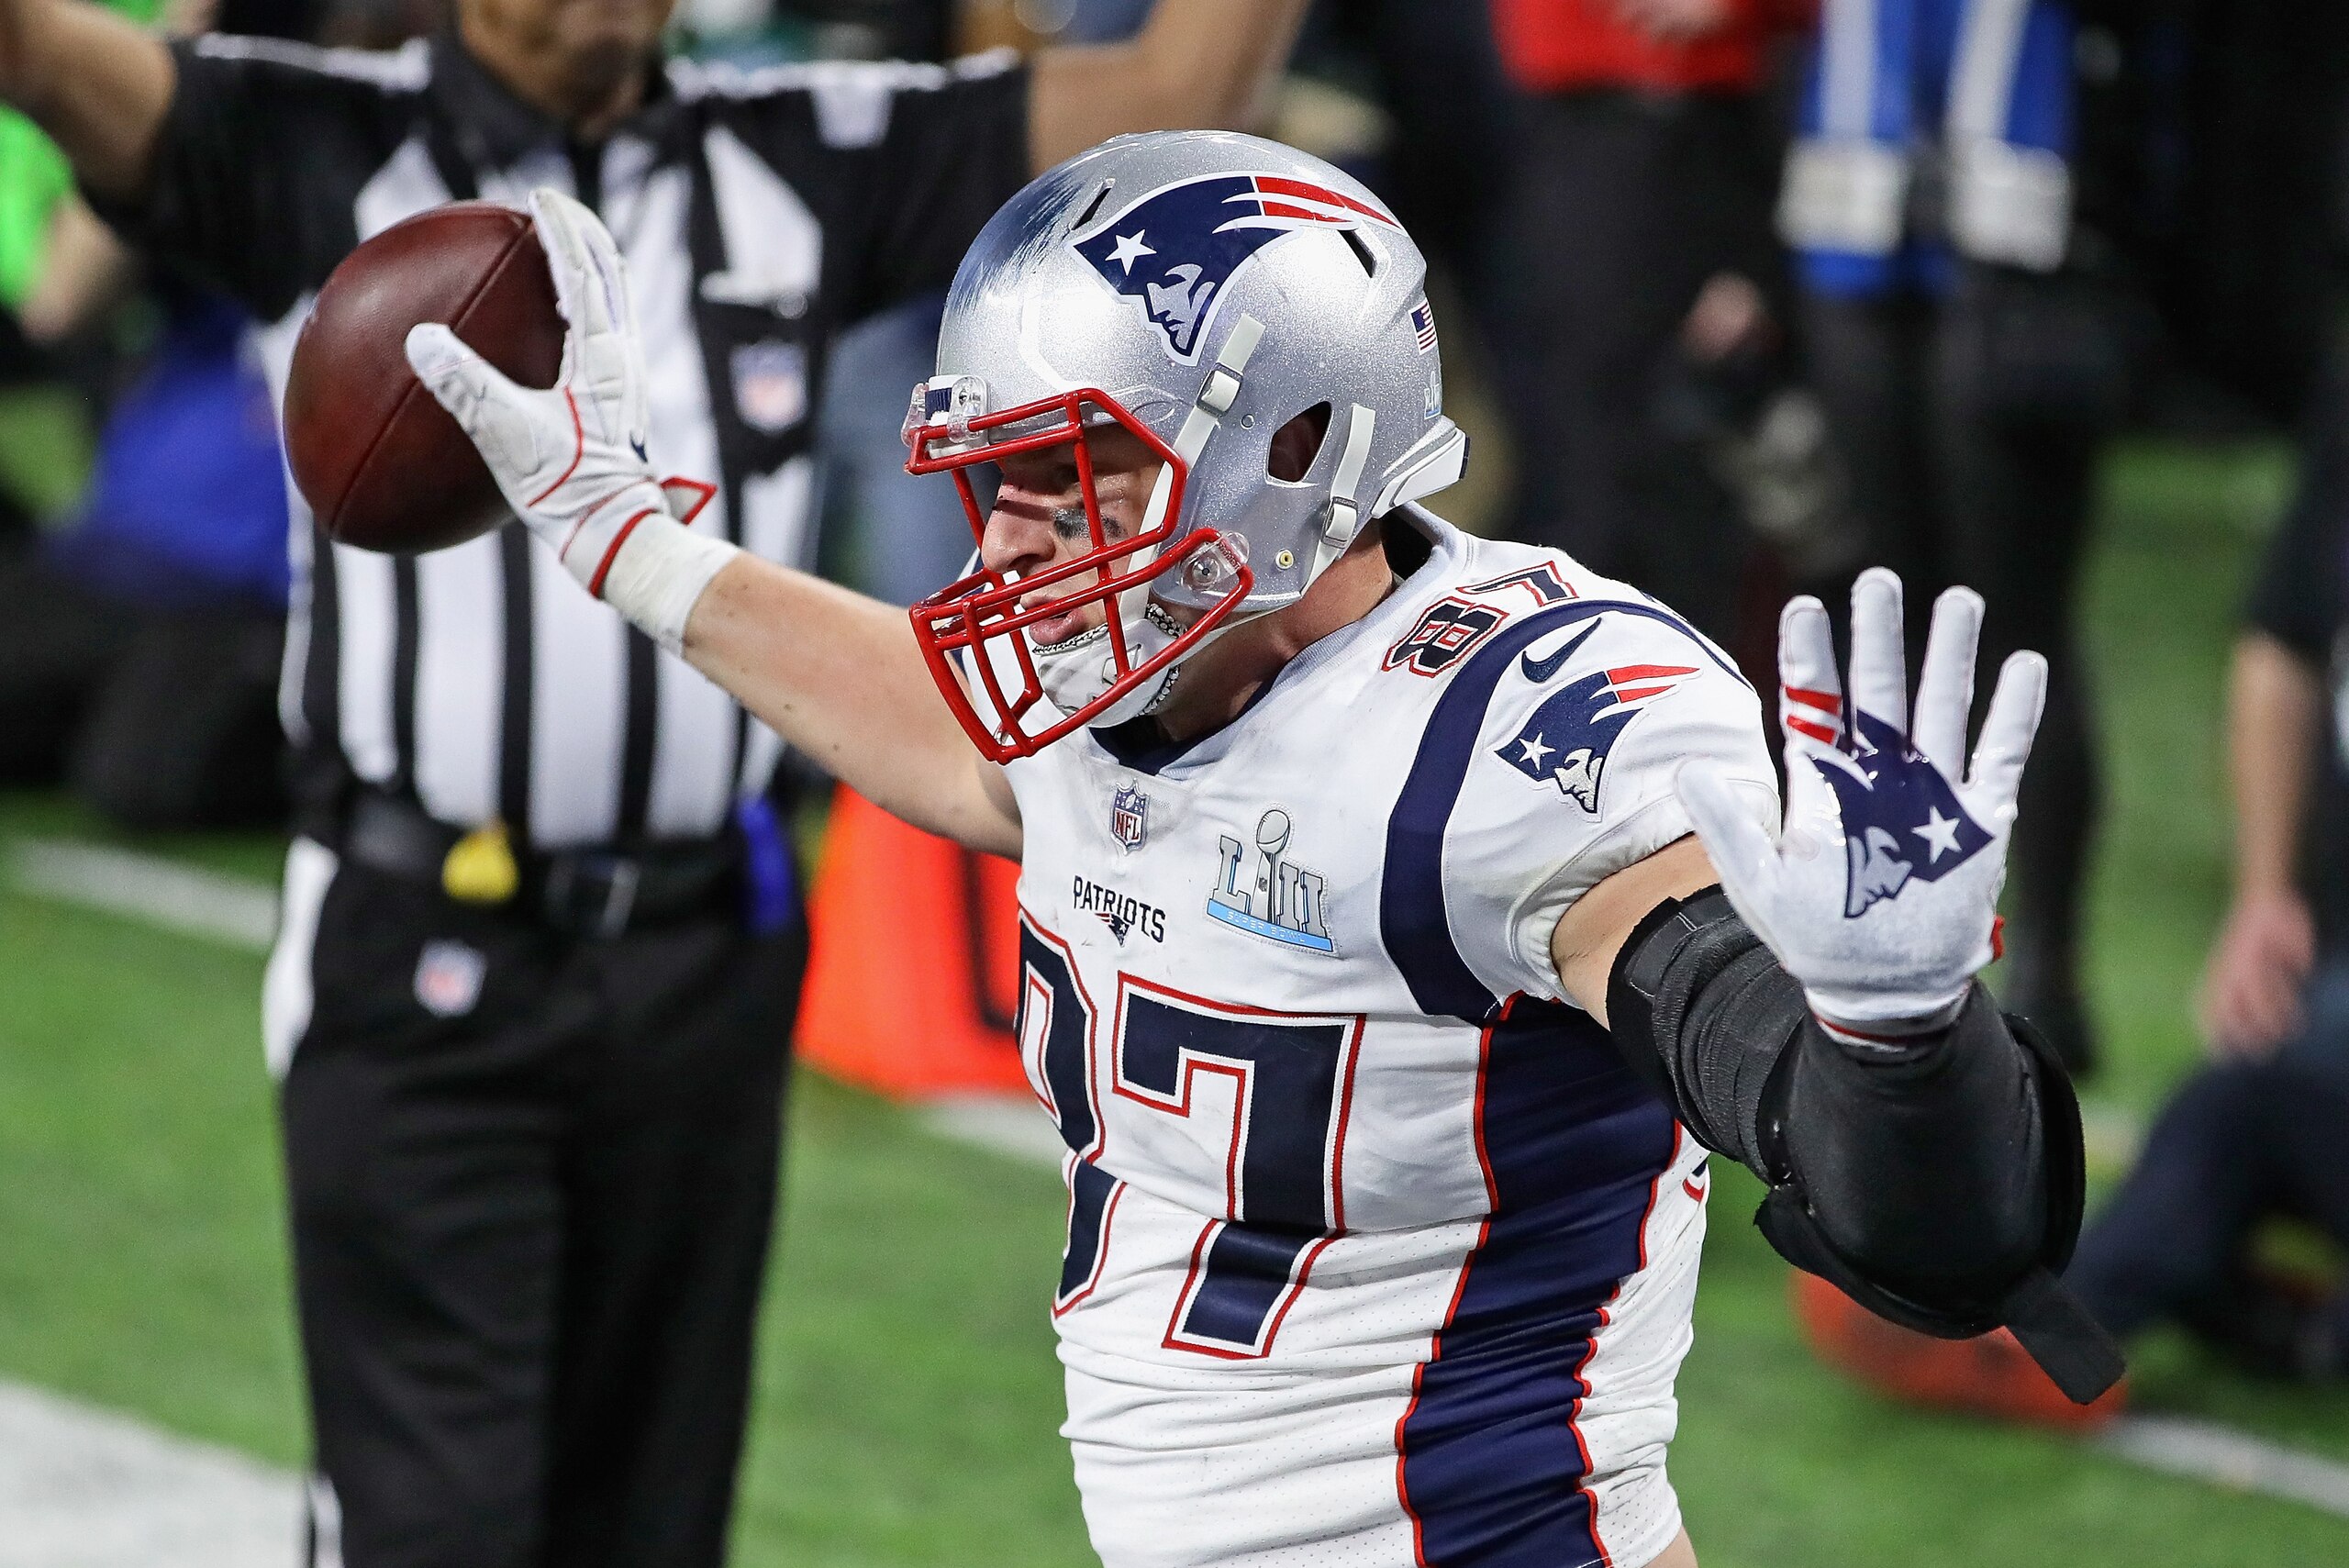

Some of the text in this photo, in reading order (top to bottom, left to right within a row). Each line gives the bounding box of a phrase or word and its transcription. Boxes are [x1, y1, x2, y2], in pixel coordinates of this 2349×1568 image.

[1381, 561, 1578, 678] 87
[1115, 811, 1140, 841] NFL
[1073, 874, 1166, 943] PATRIOTS
[1226, 910, 1306, 943] SUPER BOWL
